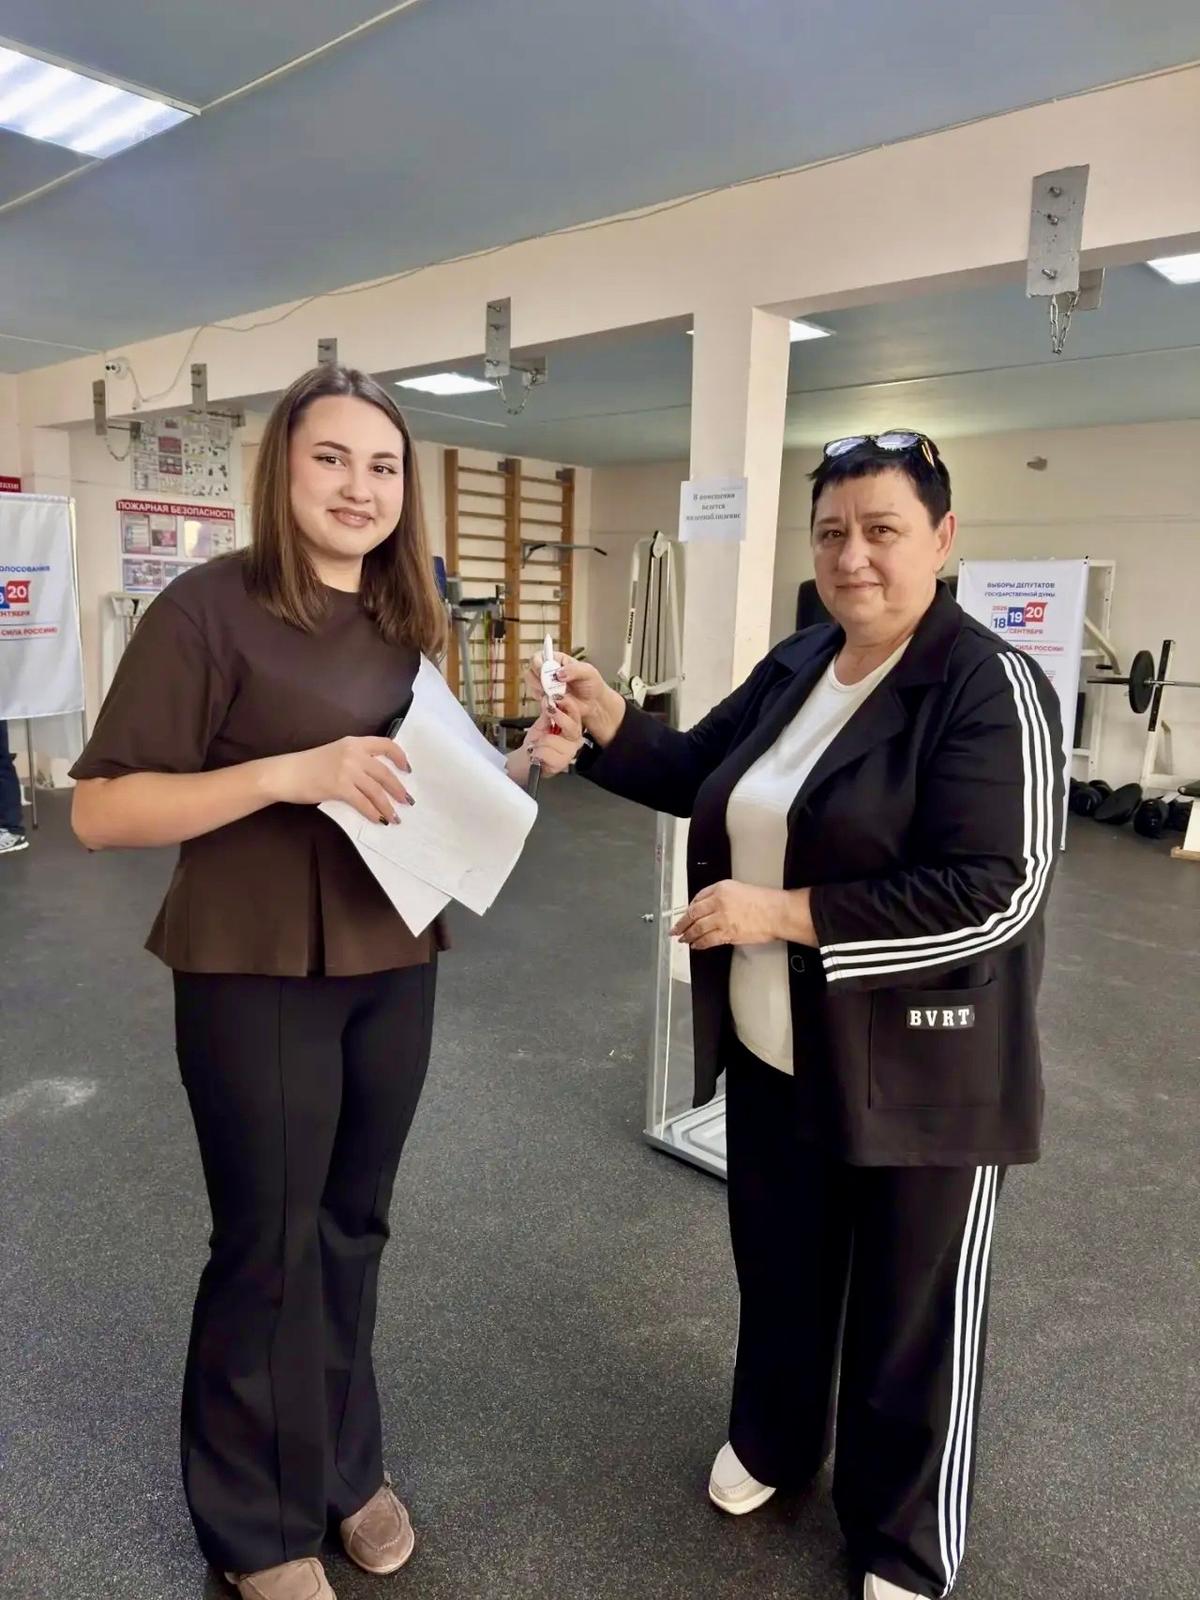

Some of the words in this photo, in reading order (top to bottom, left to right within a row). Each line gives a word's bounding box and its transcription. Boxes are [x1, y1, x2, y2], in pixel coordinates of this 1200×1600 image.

[118, 501, 168, 512] ПОЖАРНАЯ
[7, 585, 27, 599] 20
[993, 617, 1006, 629] 18
[1009, 611, 1023, 623] 19
[1025, 606, 1043, 619] 20
[910, 1009, 970, 1026] BVRT
